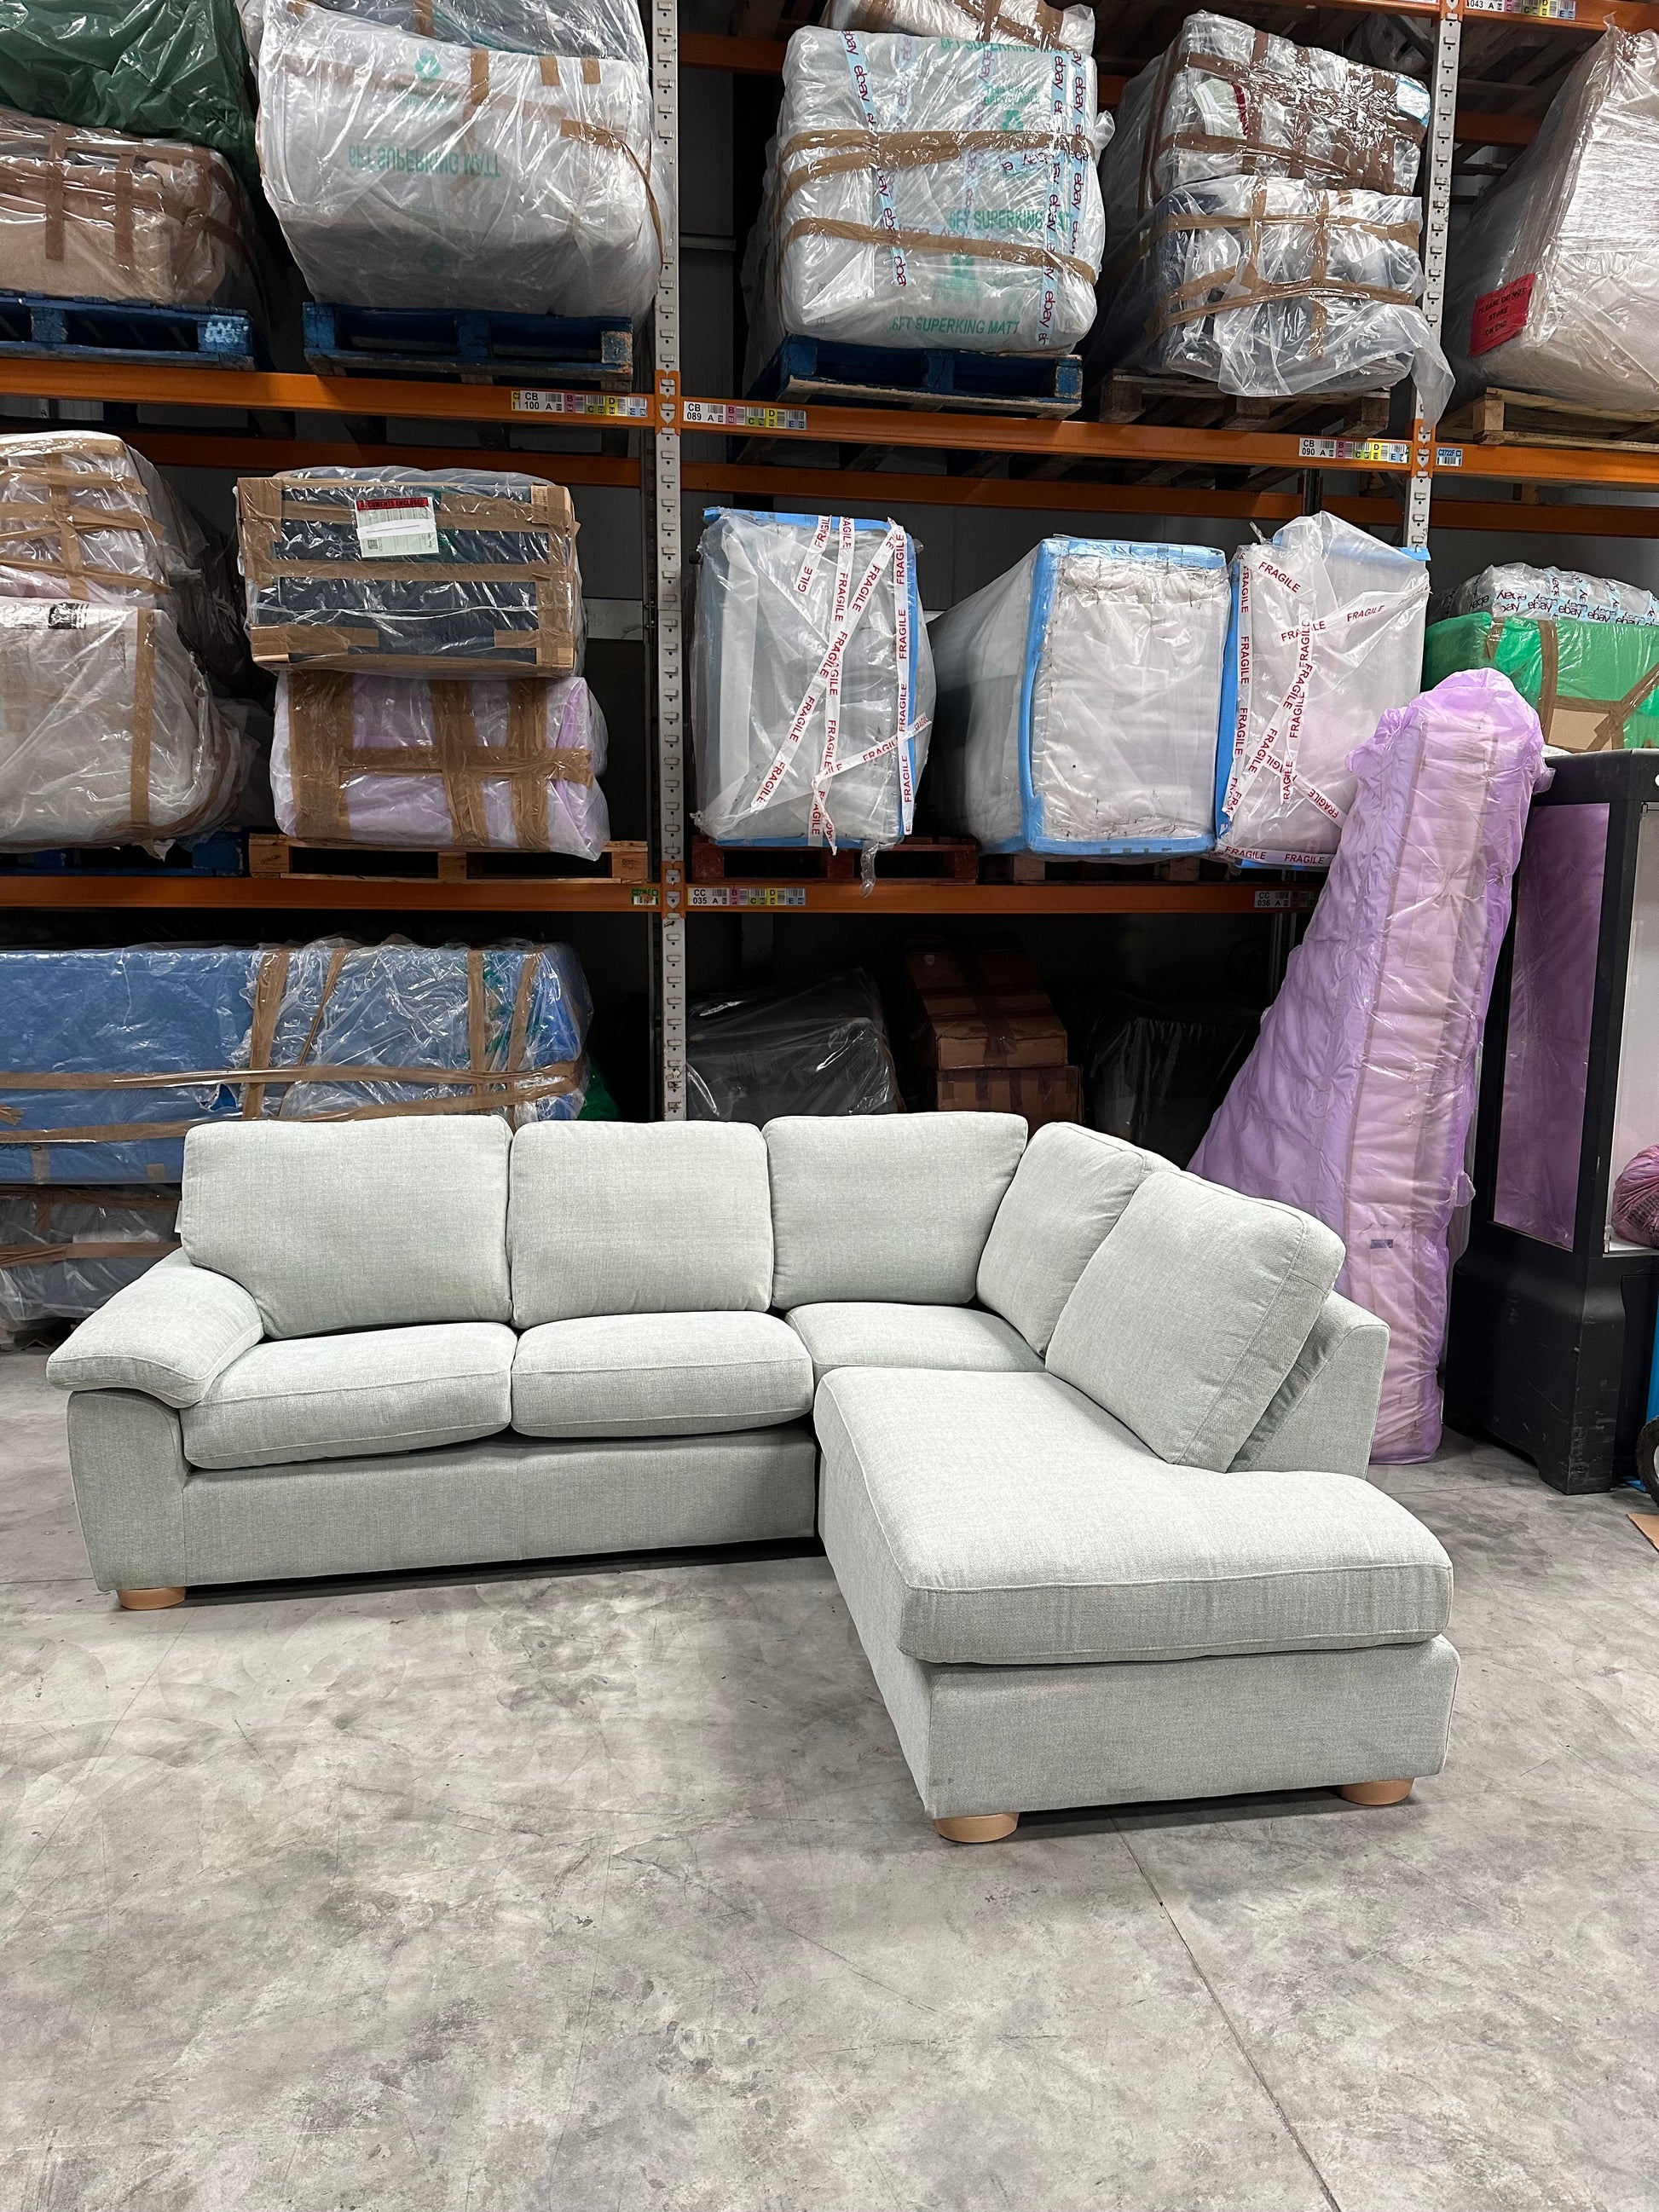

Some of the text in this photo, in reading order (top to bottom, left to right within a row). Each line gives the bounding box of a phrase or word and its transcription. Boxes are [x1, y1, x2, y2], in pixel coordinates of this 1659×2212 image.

[854, 65, 870, 101] ebay
[1052, 55, 1066, 90] ebay
[1073, 77, 1088, 114] ebay
[1072, 172, 1084, 211] ebay
[974, 210, 1044, 231] SUPERKING
[894, 256, 907, 286] eba
[892, 316, 1020, 335] 6FT SUPERKING MATT
[1039, 291, 1056, 328] ebay
[524, 401, 540, 410] 100
[525, 392, 538, 401] CB
[688, 403, 701, 412] CB
[686, 412, 702, 421] 089
[1302, 448, 1315, 456] 090
[1303, 439, 1315, 448] CB
[814, 515, 830, 548] FRAGIL
[841, 517, 852, 549] RAGILE
[1258, 561, 1301, 593] FRAGILE
[835, 572, 848, 622] FRAGILE
[1527, 598, 1552, 612] ebay
[1558, 604, 1582, 619] ebay
[1587, 609, 1610, 624] ebay
[1281, 604, 1385, 642] FRALE FRAGILE
[896, 534, 912, 803] FRAGILE FRAGILE FRAGILE FRAGILE
[1240, 636, 1250, 684] FRAGILE
[756, 564, 881, 804] FRAGILE FRAGILE FRAGILE FRAGILE
[1234, 707, 1248, 755] FRAGILE
[1248, 663, 1314, 774] FRAGILE FRAGILE
[824, 719, 836, 768] FRAGILE
[863, 739, 896, 762] FRAGIL
[1283, 759, 1293, 800] RAGILE
[1307, 788, 1339, 819] FRAGILE
[1224, 846, 1267, 860] FRAGILE
[1284, 853, 1325, 864] FRAGILE
